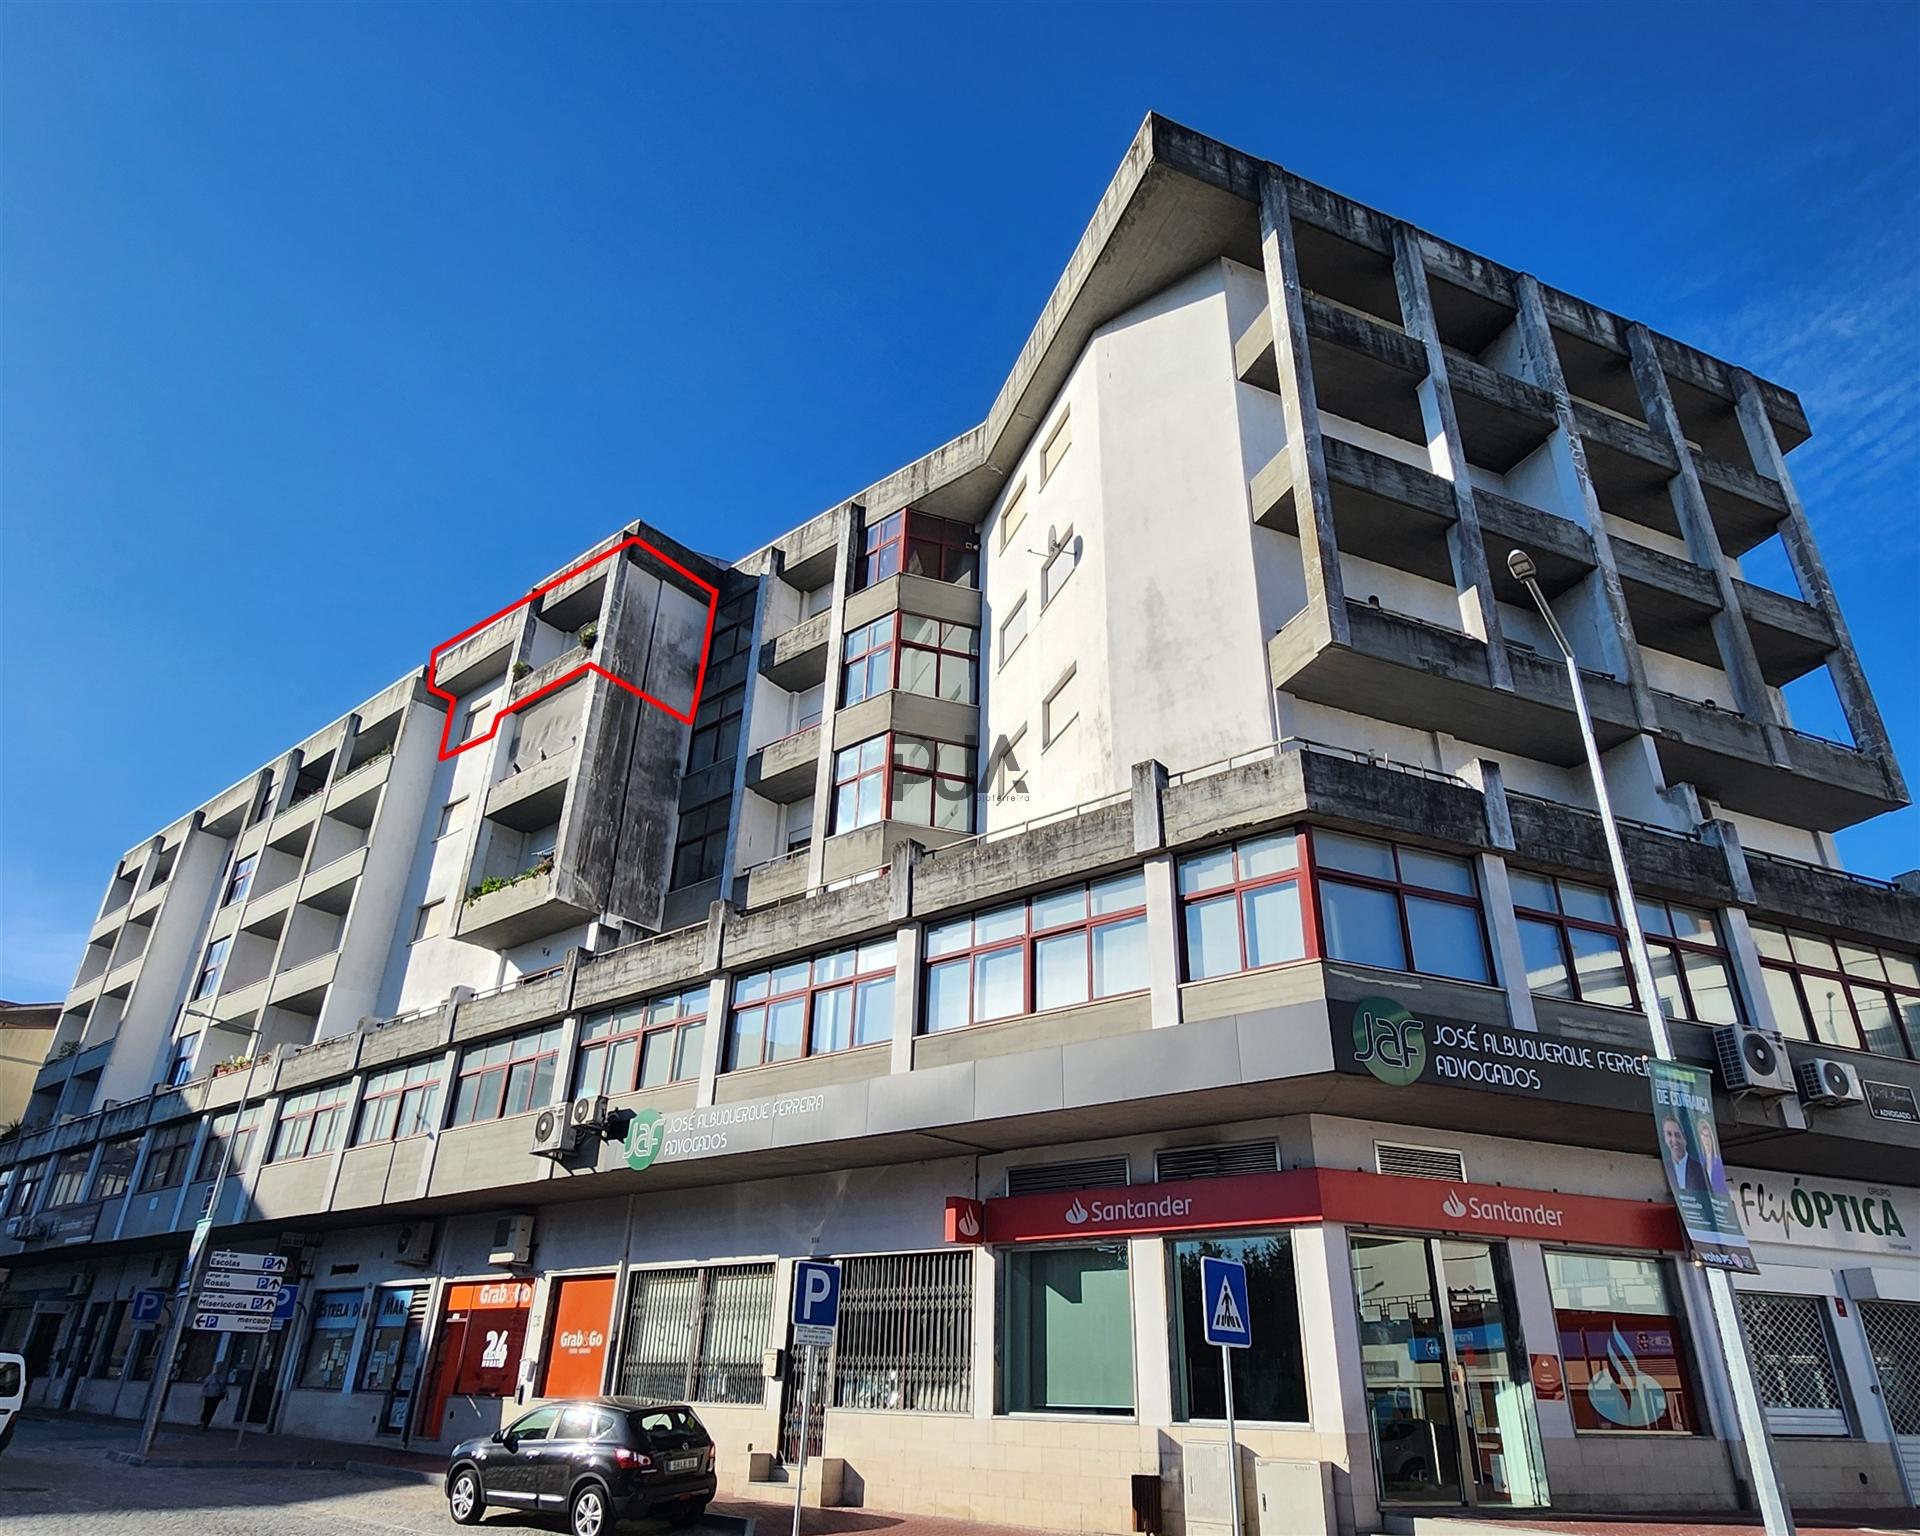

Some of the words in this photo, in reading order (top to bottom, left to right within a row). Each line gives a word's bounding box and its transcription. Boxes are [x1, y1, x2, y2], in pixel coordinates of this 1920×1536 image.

[1433, 1024, 1479, 1051] JOSÉ
[1482, 1033, 1594, 1069] ALBUQUERQUE
[1597, 1051, 1652, 1078] FERREI
[1435, 1054, 1541, 1090] ADVOGADOS
[667, 1112, 696, 1134] JOSÉ
[697, 1103, 769, 1129] ALBUQUERQUE
[772, 1094, 824, 1117] FERREIRA
[1879, 1108, 1911, 1120] ADVOGADO
[664, 1132, 728, 1155] ADVOGADOS
[1091, 1195, 1193, 1222] Santander
[1468, 1197, 1563, 1226] Santander
[210, 1258, 240, 1267] Escolas
[264, 1259, 273, 1268] P
[204, 1278, 231, 1288] Rossio
[259, 1279, 268, 1288] P
[803, 1268, 831, 1320] P
[138, 1295, 158, 1317] P
[198, 1299, 247, 1309] Misericórdia
[254, 1299, 262, 1308] P
[209, 1316, 217, 1327] P
[237, 1317, 270, 1325] mercado
[560, 1330, 603, 1347] Grab&Go
